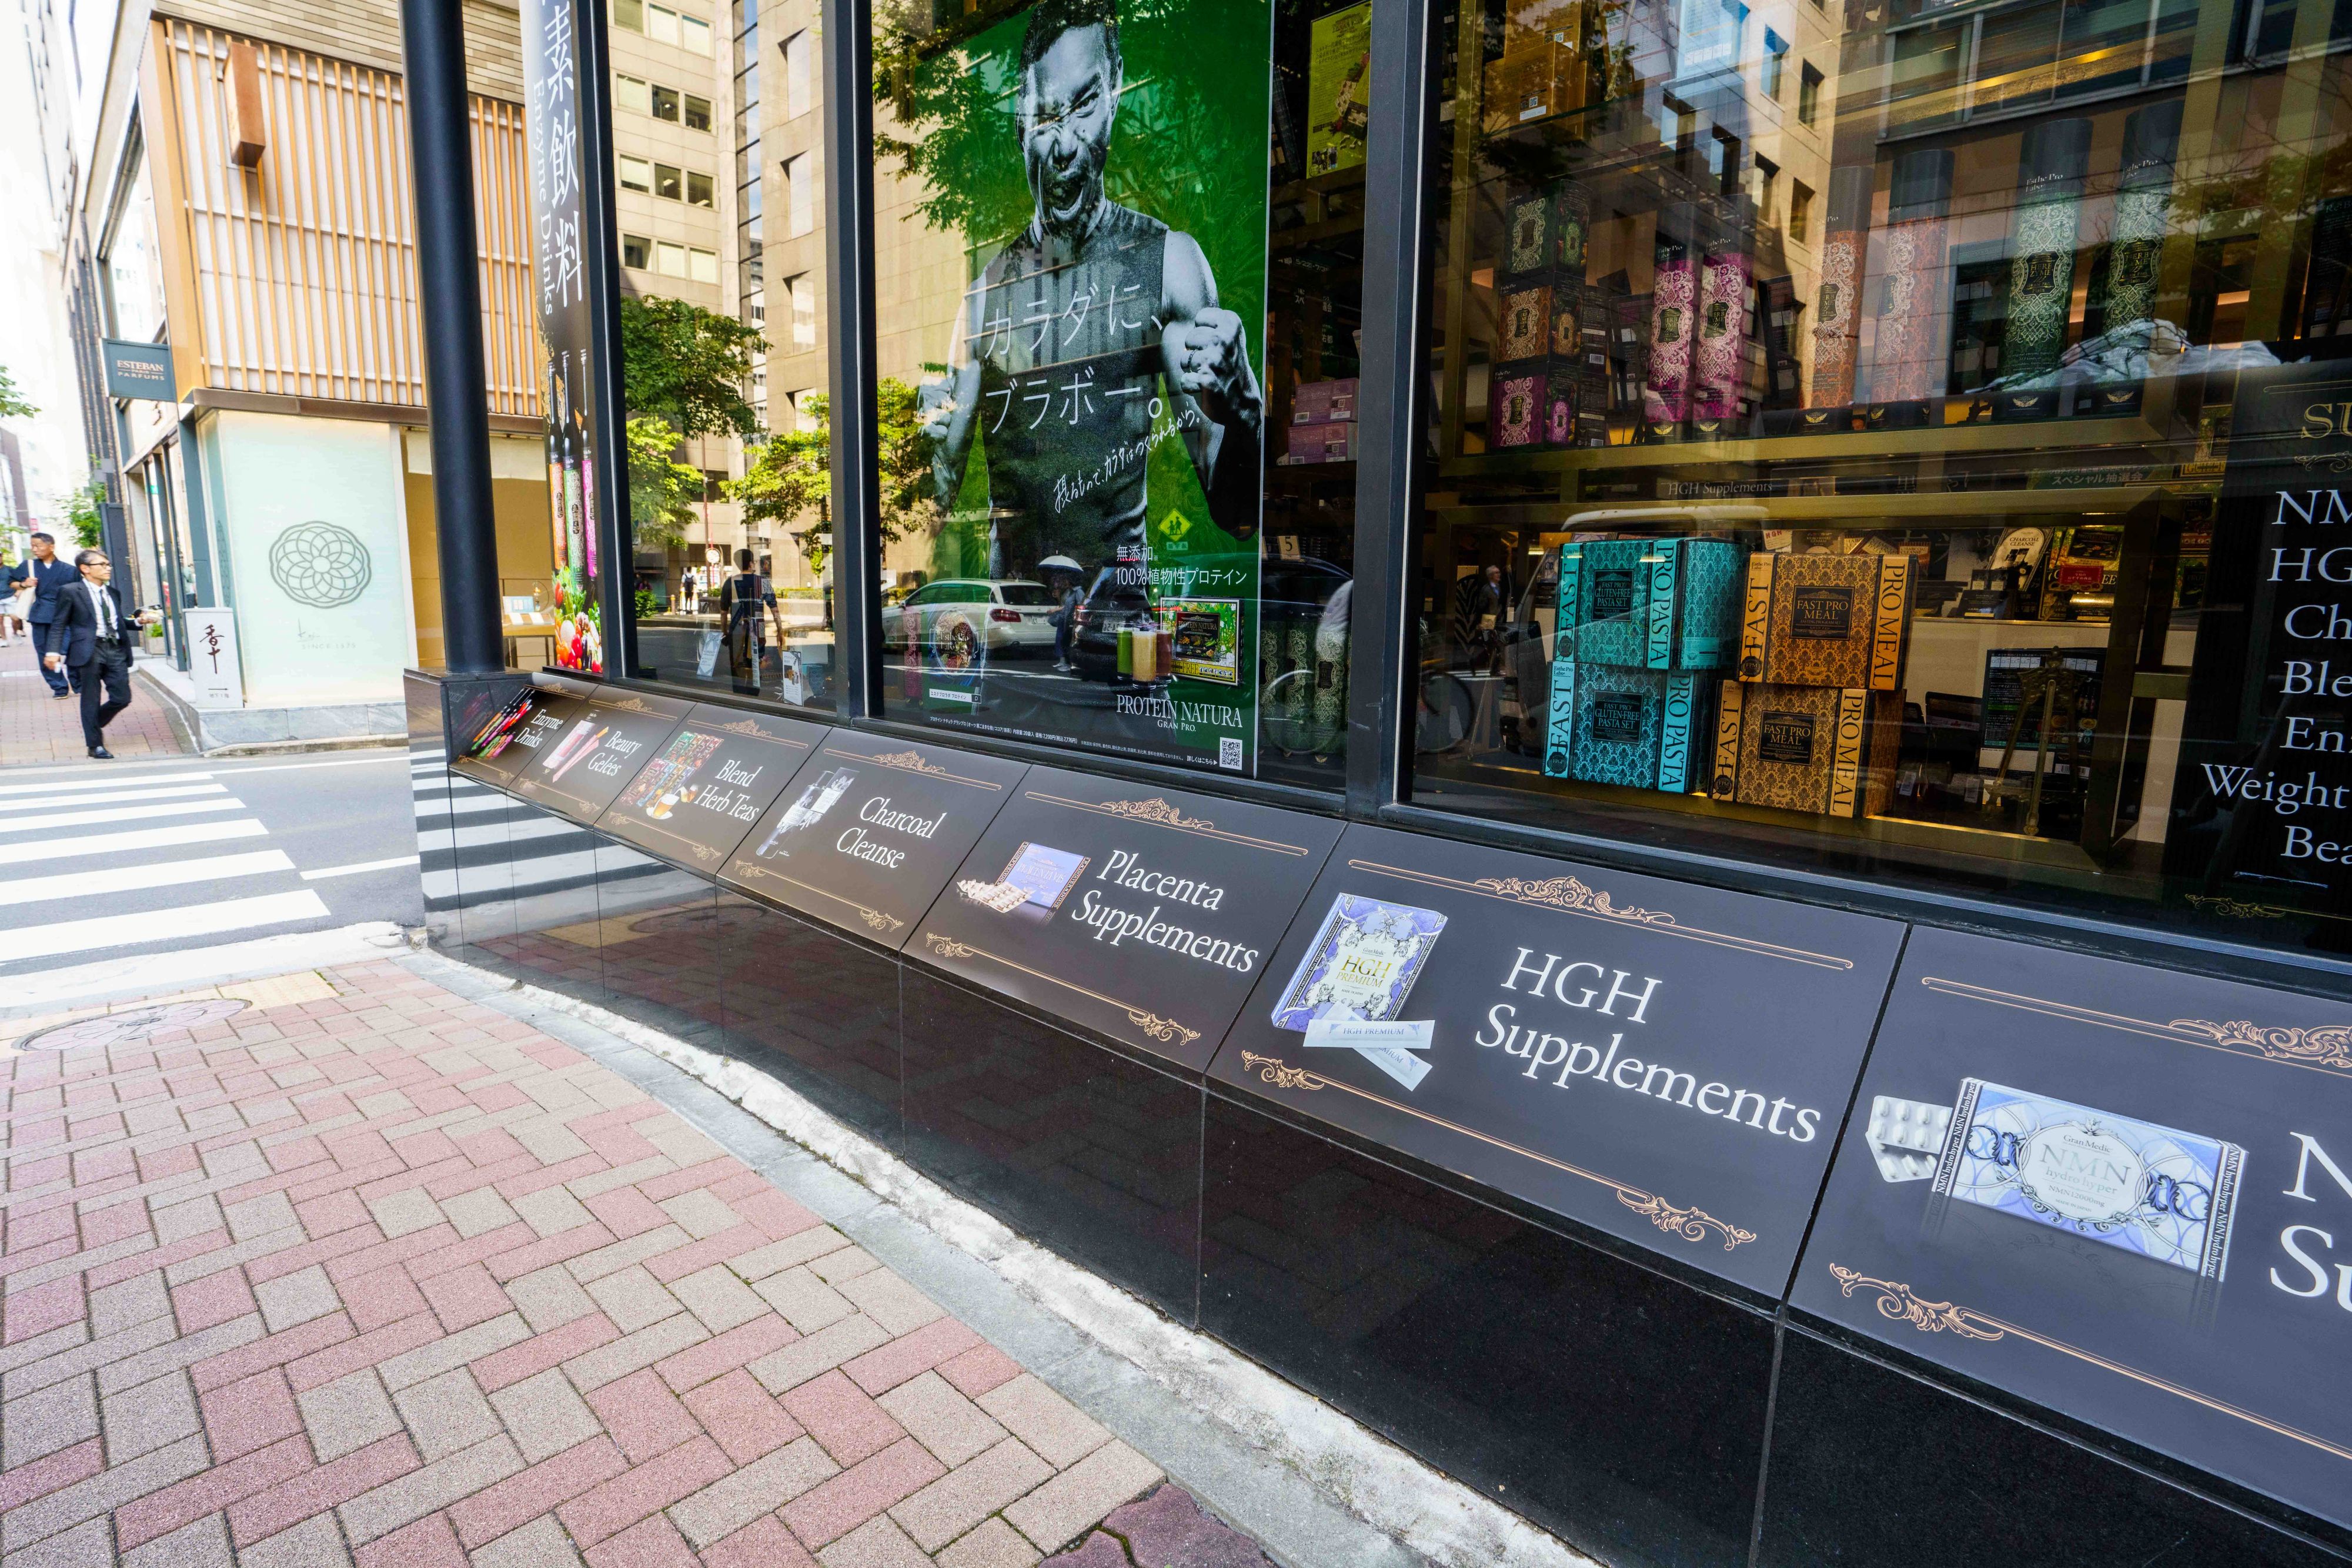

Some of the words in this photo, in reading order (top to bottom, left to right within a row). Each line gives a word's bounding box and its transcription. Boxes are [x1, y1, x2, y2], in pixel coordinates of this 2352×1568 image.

[544, 0, 582, 307] 素飲料
[2026, 175, 2047, 186] Esthe
[533, 79, 547, 203] Enzyme
[540, 214, 553, 316] Drinks
[985, 282, 1162, 359] カラダに、
[117, 359, 164, 372] ESTEBAN
[118, 372, 165, 380] PARFUMS
[985, 366, 1163, 434] ブラボー。
[1668, 482, 1699, 495] HGH
[1703, 481, 1772, 497] Supplements
[1285, 536, 1293, 551] 5
[1117, 567, 1247, 586] 100%植物性プロテイン
[1654, 545, 1674, 591] PRO
[1561, 563, 1578, 633] FAST
[1595, 589, 1631, 598] GLUTEN-FREE
[1881, 563, 1906, 611] PRO
[1597, 597, 1615, 607] PASTA
[1616, 598, 1628, 607] SET
[1745, 577, 1769, 650] FAST
[1797, 600, 1823, 610] FAST
[1828, 601, 1849, 611] PRO
[1804, 610, 1839, 620] MEAL
[1198, 622, 1217, 630] NATURA
[1650, 597, 1671, 664] PASTA
[1872, 616, 1900, 687] MEAL
[1668, 672, 1691, 717] PRO
[530, 708, 564, 731] Enzyme
[1117, 694, 1178, 720] PROTEIN
[1181, 701, 1242, 728] NATURA
[1550, 679, 1572, 752] FAST
[1595, 709, 1640, 721] GLUTEN-FREE
[1598, 717, 1620, 728] PASTA
[1621, 720, 1636, 730] SET
[1840, 693, 1863, 740] PRO
[514, 727, 543, 748] Drinks
[1717, 700, 1739, 771] FAST
[1764, 724, 1789, 734] FAST
[1790, 727, 1811, 737] PRO
[1770, 734, 1802, 745] MEAL
[604, 731, 643, 759] Beauty
[1662, 723, 1687, 788] PASTA
[715, 759, 764, 787] Blend
[1832, 744, 1857, 813] MEAL
[2200, 763, 2350, 815] Weight
[694, 784, 734, 812] Herb
[727, 793, 760, 821] Teas
[859, 797, 947, 839] Charcoal
[836, 827, 906, 870] Cleanse
[1096, 850, 1224, 911] Placenta
[1071, 890, 1259, 973] Supplements
[1335, 972, 1385, 988] PREMIUM
[1341, 955, 1392, 979] HGH
[1501, 947, 1662, 1024] HGH
[1475, 1004, 1821, 1142] Supplements
[1963, 1082, 1976, 1101] hyper
[1961, 1099, 1970, 1118] hydro
[1953, 1116, 1966, 1138] NMN
[1947, 1137, 1960, 1157] hyper
[2063, 1134, 2084, 1146] Gran
[2086, 1140, 2112, 1153] Medic
[1942, 1154, 1955, 1175] hydro
[2039, 1143, 2132, 1185] NMN
[2226, 1149, 2240, 1175] NMN
[1936, 1172, 1947, 1193] NMN
[2046, 1166, 2080, 1183] hydro
[2082, 1177, 2117, 1194] hyper
[2223, 1172, 2236, 1193] hydro
[2219, 1188, 2232, 1213] hyper
[2216, 1212, 2228, 1239] NMN
[2212, 1235, 2224, 1259] hydro
[2207, 1253, 2221, 1278] hyper
